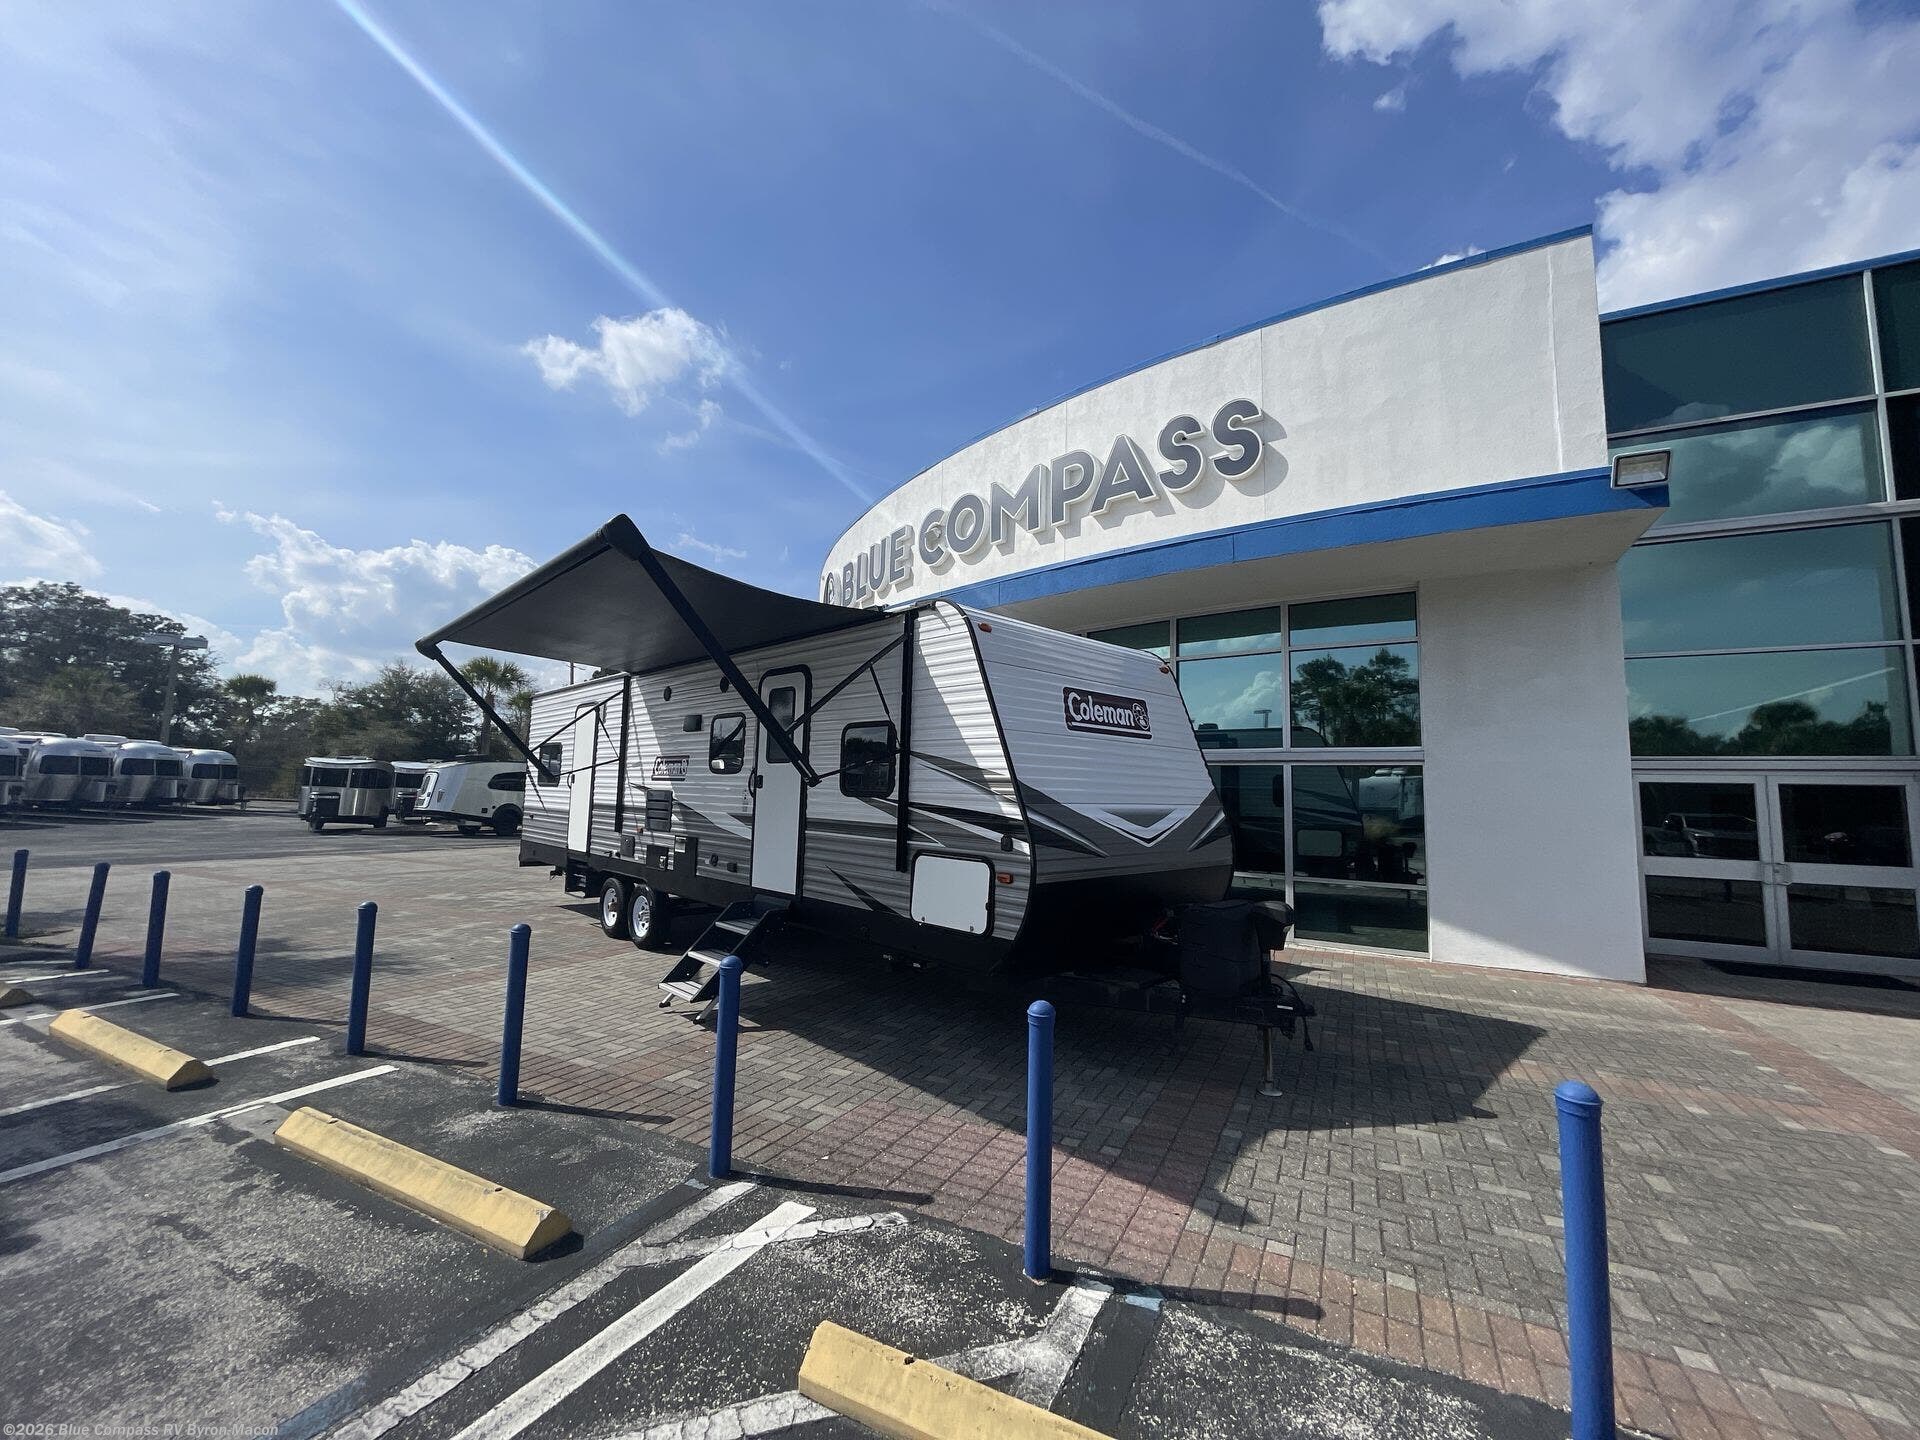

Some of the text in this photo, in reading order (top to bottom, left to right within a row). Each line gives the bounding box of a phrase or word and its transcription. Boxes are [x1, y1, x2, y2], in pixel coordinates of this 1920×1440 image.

[842, 397, 1263, 607] BLUE COMPASS
[1067, 691, 1135, 727] Coleman
